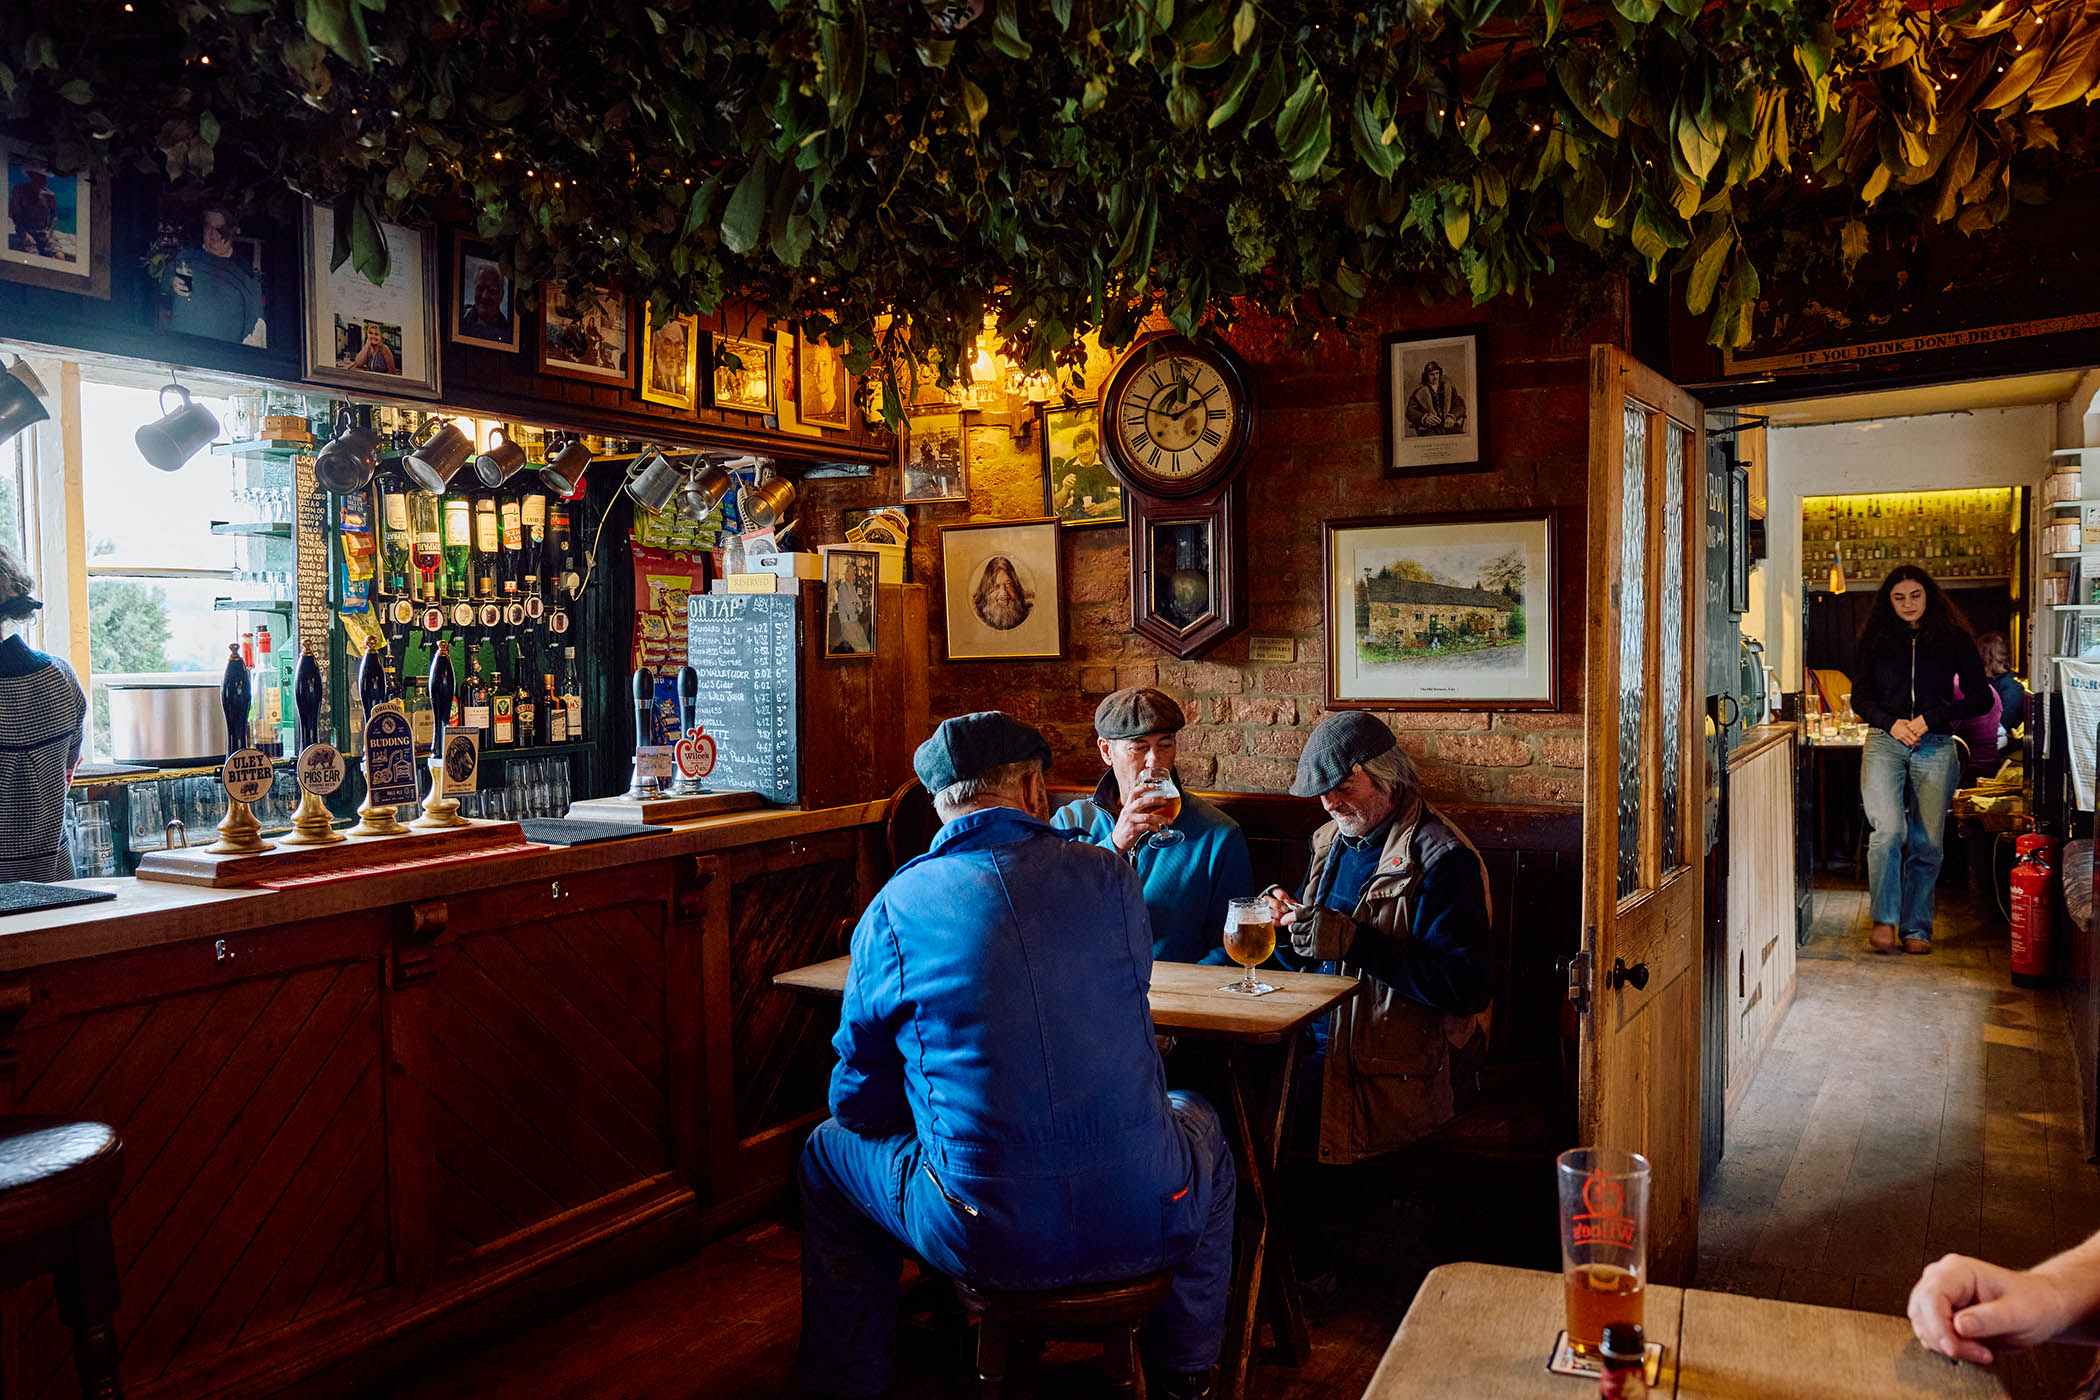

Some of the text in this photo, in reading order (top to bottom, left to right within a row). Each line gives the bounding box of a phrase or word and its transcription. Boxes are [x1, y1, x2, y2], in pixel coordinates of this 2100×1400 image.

[1822, 347, 1851, 362] YOU
[1914, 333, 1962, 351] DON'T
[734, 578, 769, 586] RESERVED
[690, 599, 707, 618] ON
[711, 599, 740, 618] TAP
[370, 736, 410, 748] BUDDING
[233, 754, 264, 769] ULEY
[684, 751, 710, 760] Wilce's
[228, 767, 272, 783] BITTER
[304, 769, 341, 784] PIGS EAR
